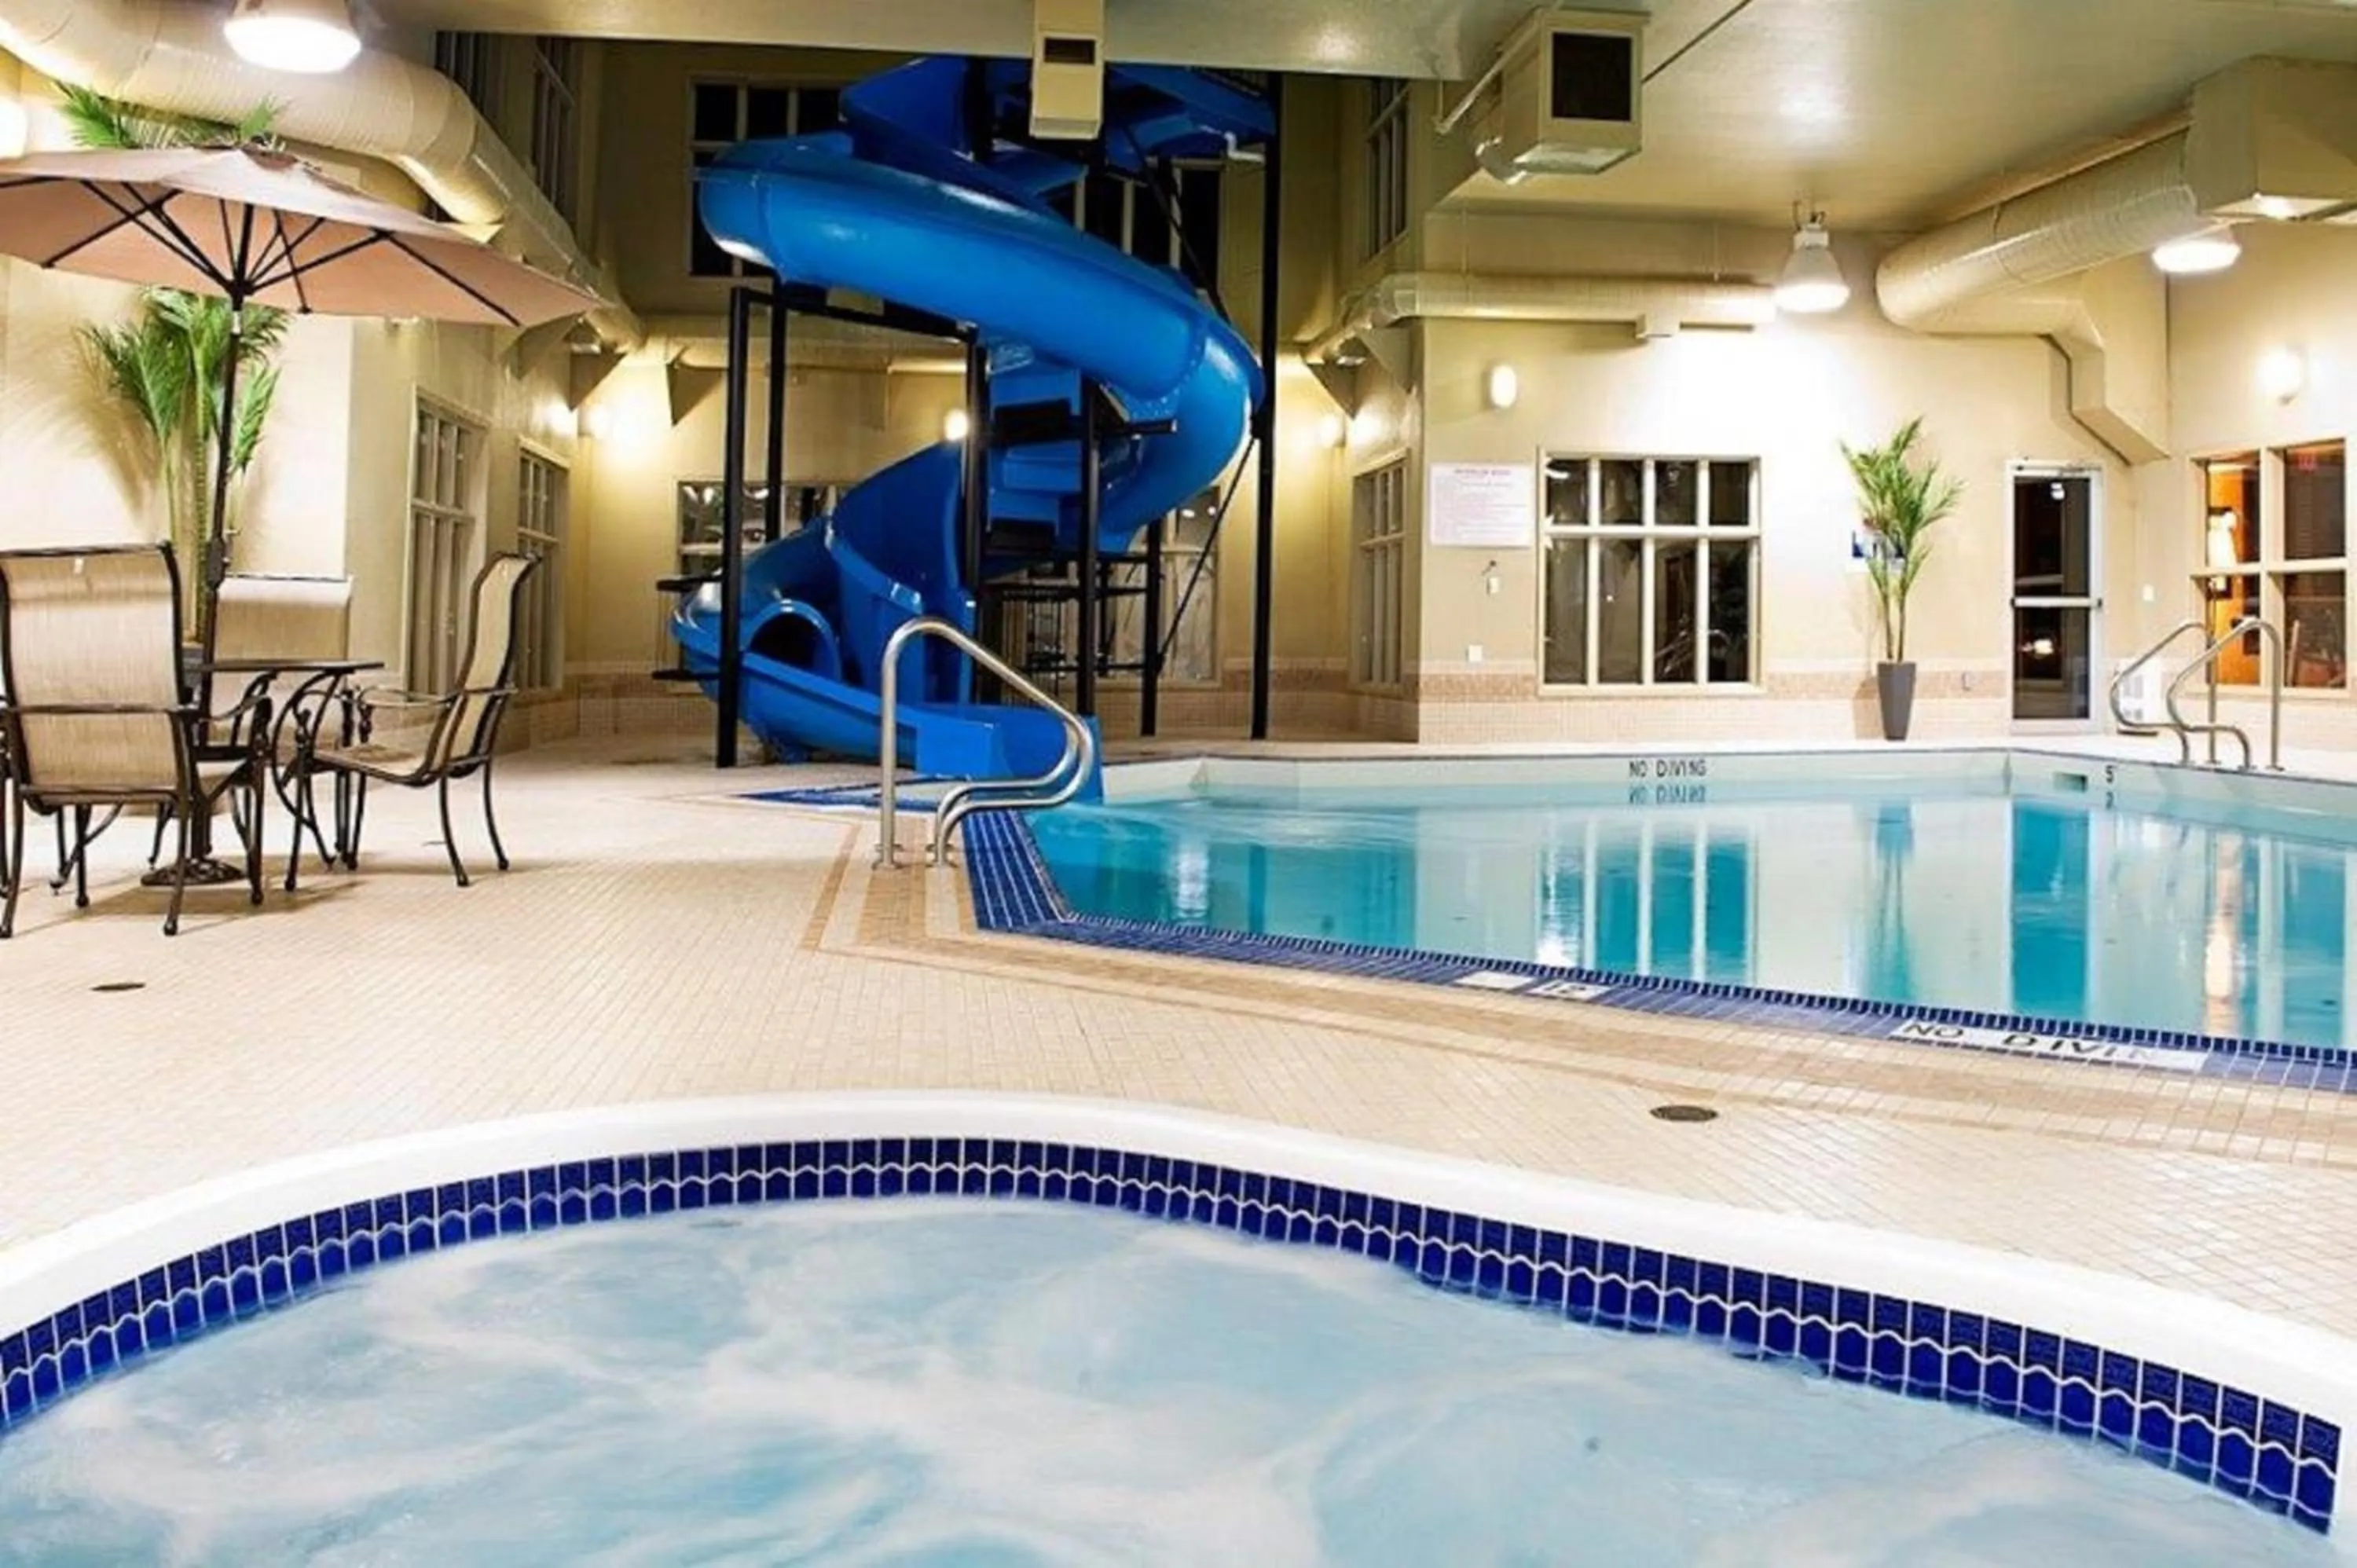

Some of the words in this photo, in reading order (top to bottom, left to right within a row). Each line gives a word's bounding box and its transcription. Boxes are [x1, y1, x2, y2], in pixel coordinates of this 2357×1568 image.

[1629, 760, 1648, 778] NO
[1656, 759, 1707, 778] DIVING
[1904, 1024, 1964, 1038] NO
[2003, 1033, 2156, 1060] DIVIN
